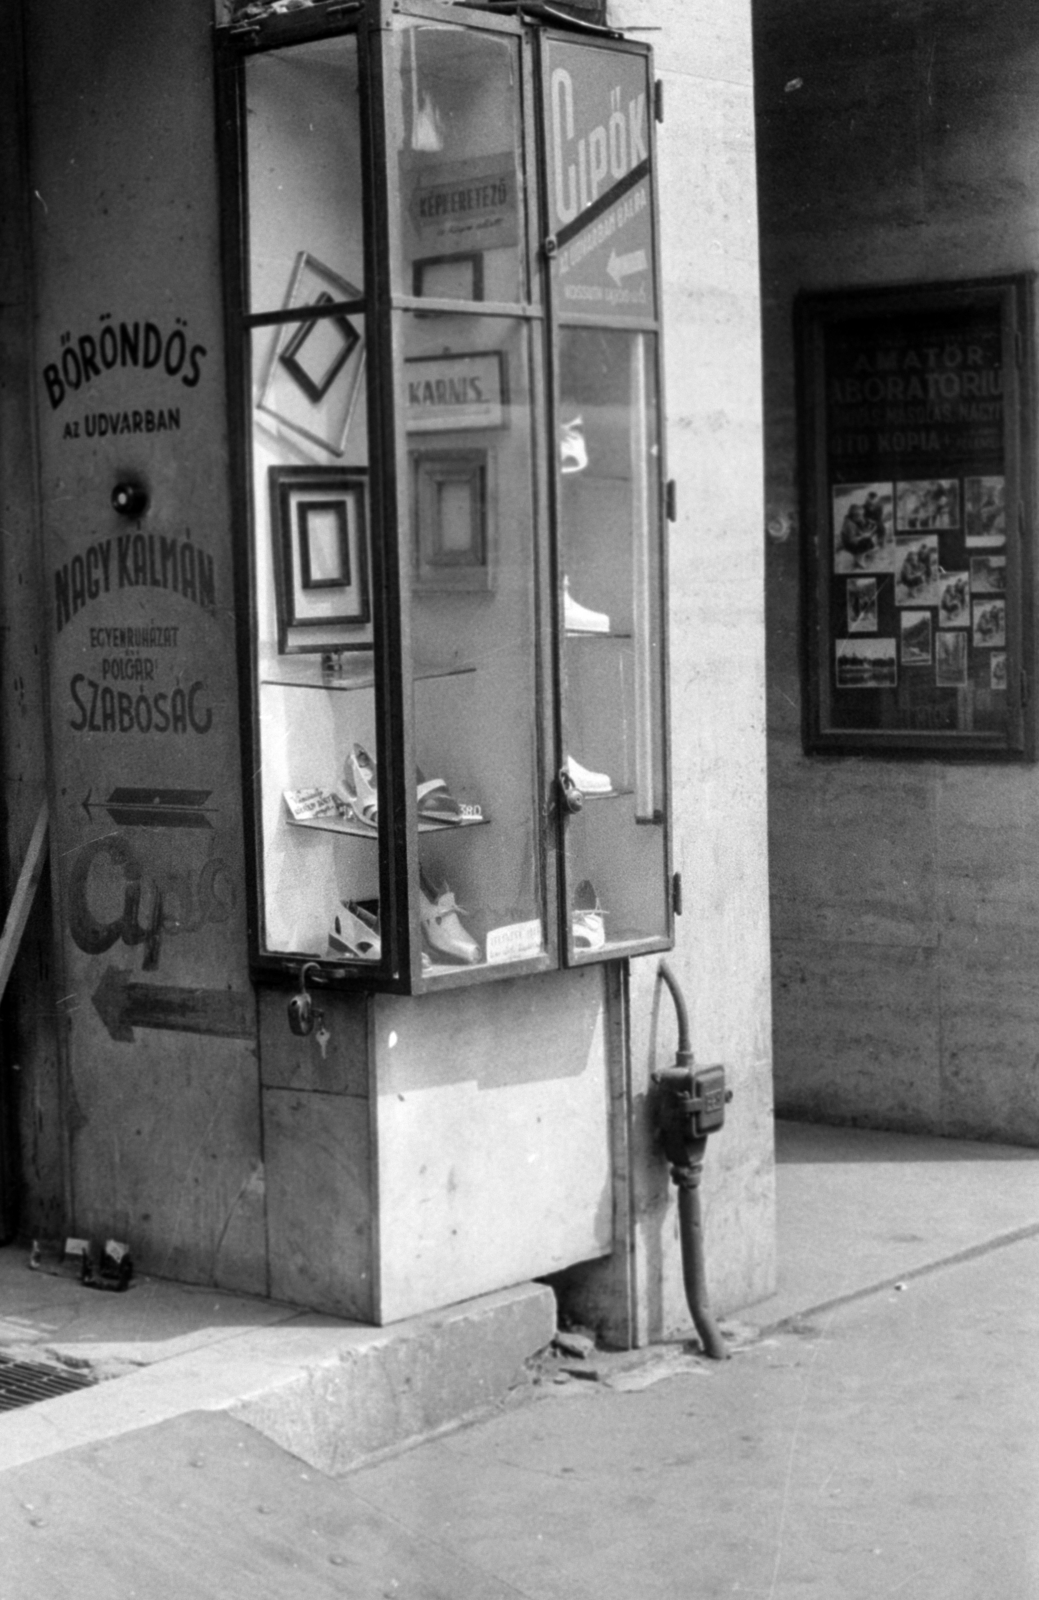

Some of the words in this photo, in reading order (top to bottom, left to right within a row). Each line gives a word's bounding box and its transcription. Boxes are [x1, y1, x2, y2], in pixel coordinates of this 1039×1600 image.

[408, 375, 483, 405] KARNIS
[63, 421, 81, 440] AZ
[84, 407, 181, 438] UDVARBAN
[55, 535, 112, 634] NAGY
[117, 514, 215, 610] KÁLMÁN
[69, 672, 213, 735] SZABÓSÁG
[458, 803, 482, 816] 380
